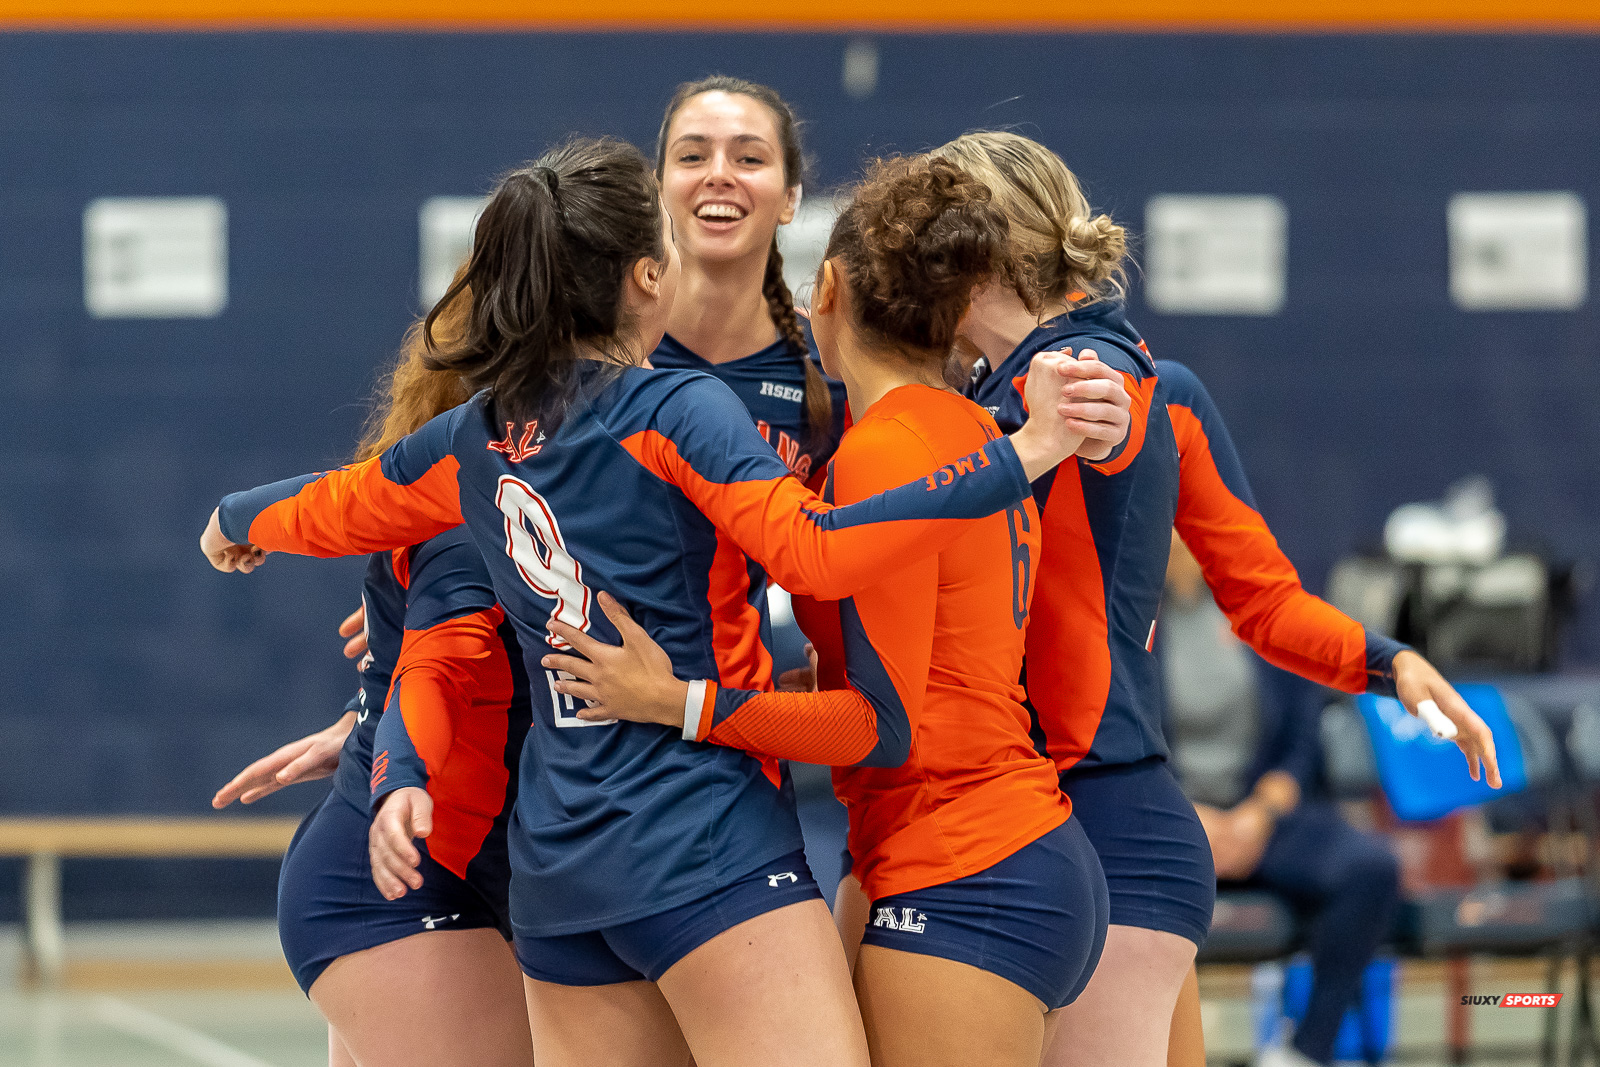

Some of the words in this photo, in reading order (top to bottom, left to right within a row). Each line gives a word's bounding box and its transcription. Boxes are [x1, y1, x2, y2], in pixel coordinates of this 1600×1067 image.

[494, 473, 592, 651] 9
[1005, 499, 1031, 630] 6
[873, 907, 926, 934] AL
